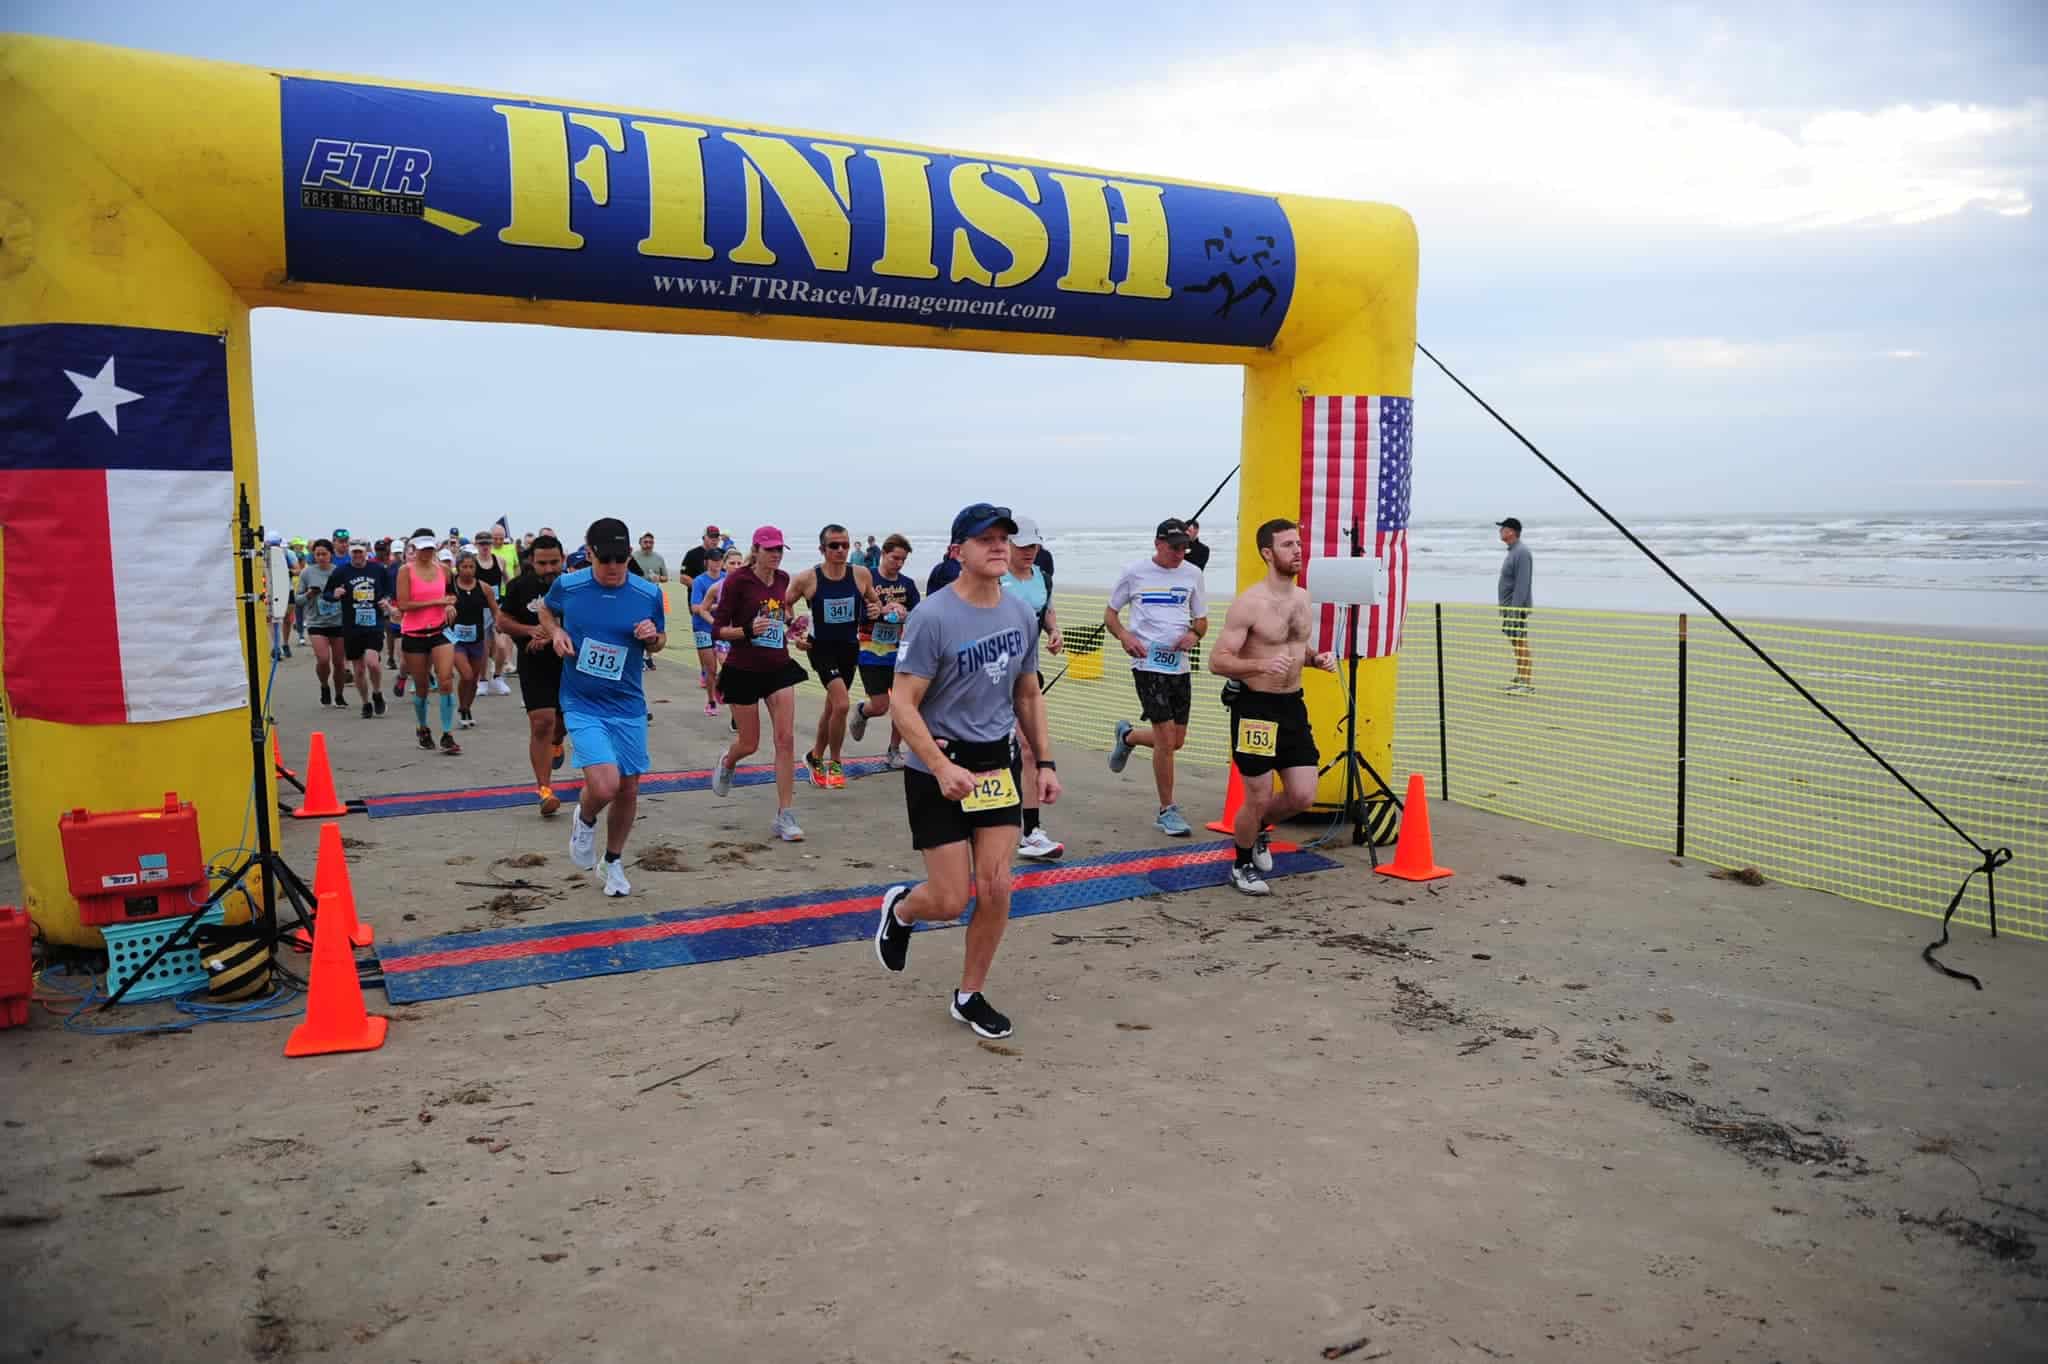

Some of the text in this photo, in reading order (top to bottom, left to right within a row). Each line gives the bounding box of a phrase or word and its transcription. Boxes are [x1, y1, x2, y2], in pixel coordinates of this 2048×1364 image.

[302, 138, 432, 195] FTR
[303, 191, 421, 215] RACE MANAGEMENT
[492, 104, 1172, 299] FINISH
[652, 274, 1057, 320] www.FTRRaceManagement.com
[831, 606, 848, 617] 341
[587, 650, 616, 670] 313
[957, 630, 1024, 678] FINISHER
[1245, 730, 1269, 746] 153
